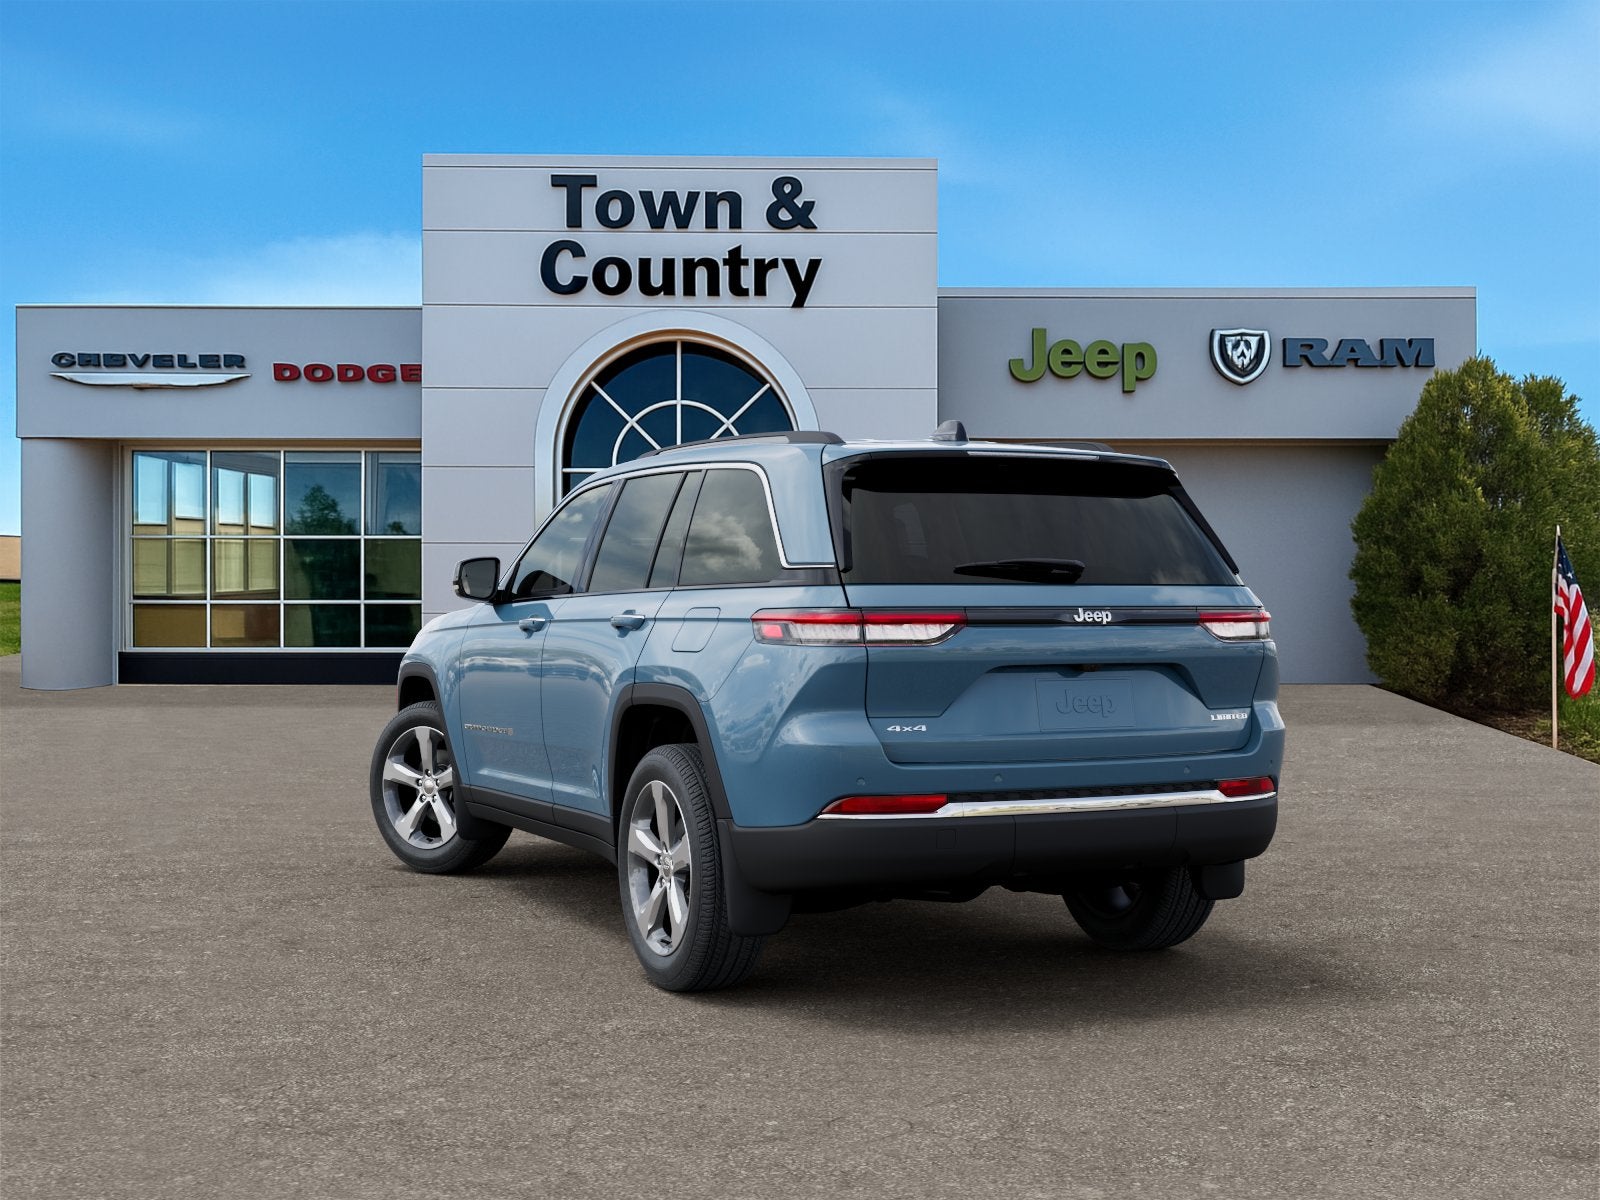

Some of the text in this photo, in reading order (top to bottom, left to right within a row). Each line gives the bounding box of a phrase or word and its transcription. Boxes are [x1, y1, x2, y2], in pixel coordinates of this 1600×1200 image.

[551, 174, 818, 230] Town &
[540, 239, 822, 308] Country
[1009, 328, 1157, 393] Jeep
[1283, 337, 1436, 368] RAM
[273, 363, 422, 383] DODGE
[1073, 608, 1112, 625] Jeep
[1055, 688, 1117, 719] Jeep
[886, 724, 927, 732] 4x4
